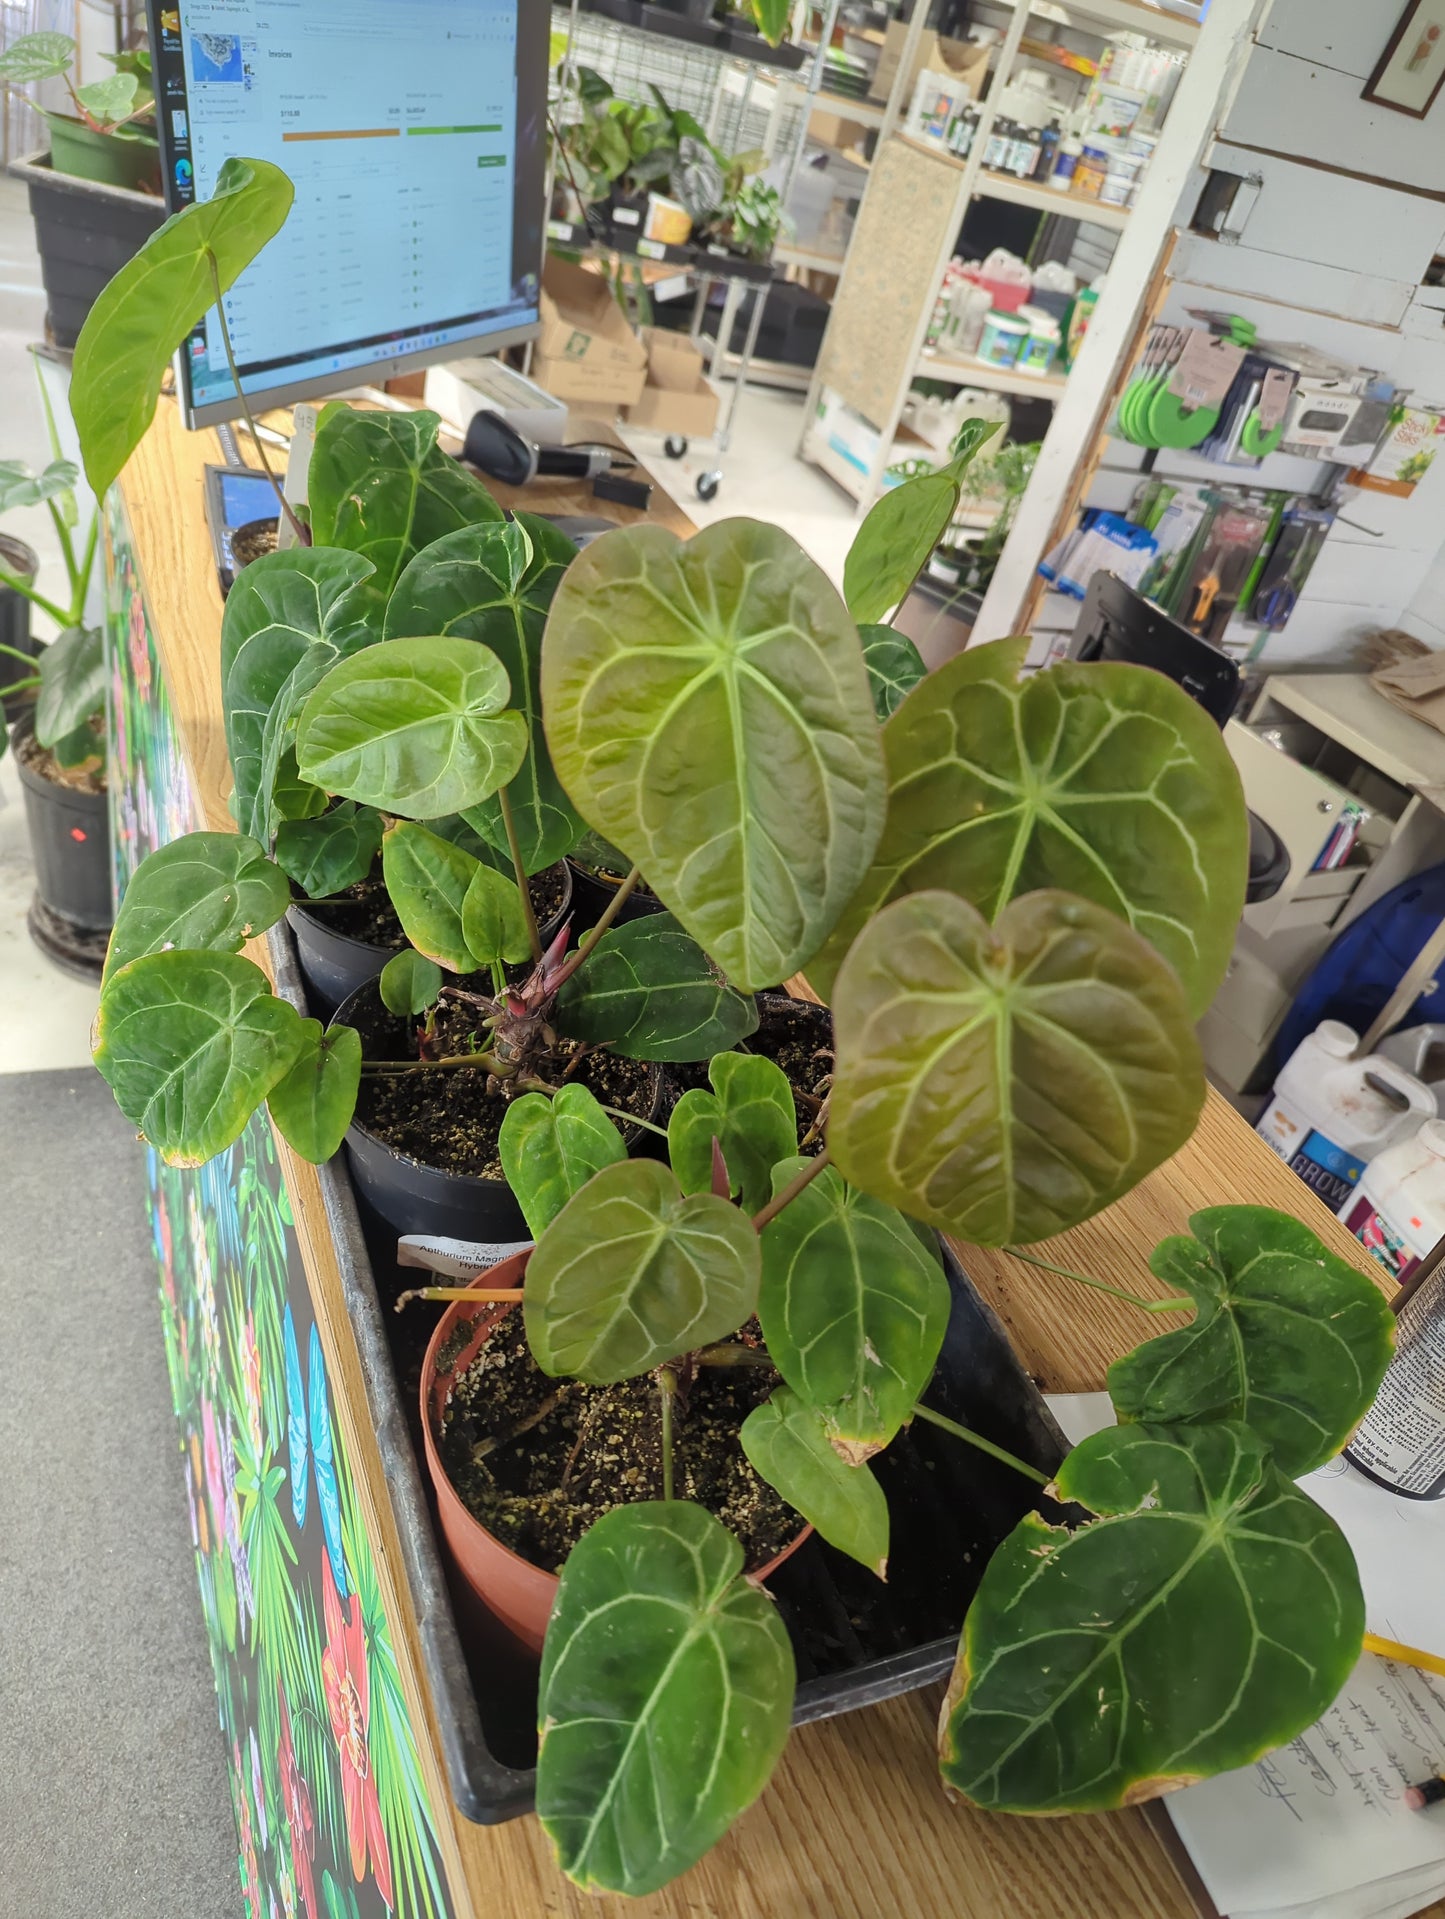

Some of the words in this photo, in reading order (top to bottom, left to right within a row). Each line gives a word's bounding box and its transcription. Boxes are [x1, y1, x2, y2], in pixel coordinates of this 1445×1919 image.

[1290, 1153, 1352, 1202] GROW
[419, 1245, 472, 1261] Anthurium
[475, 1254, 512, 1264] Magni
